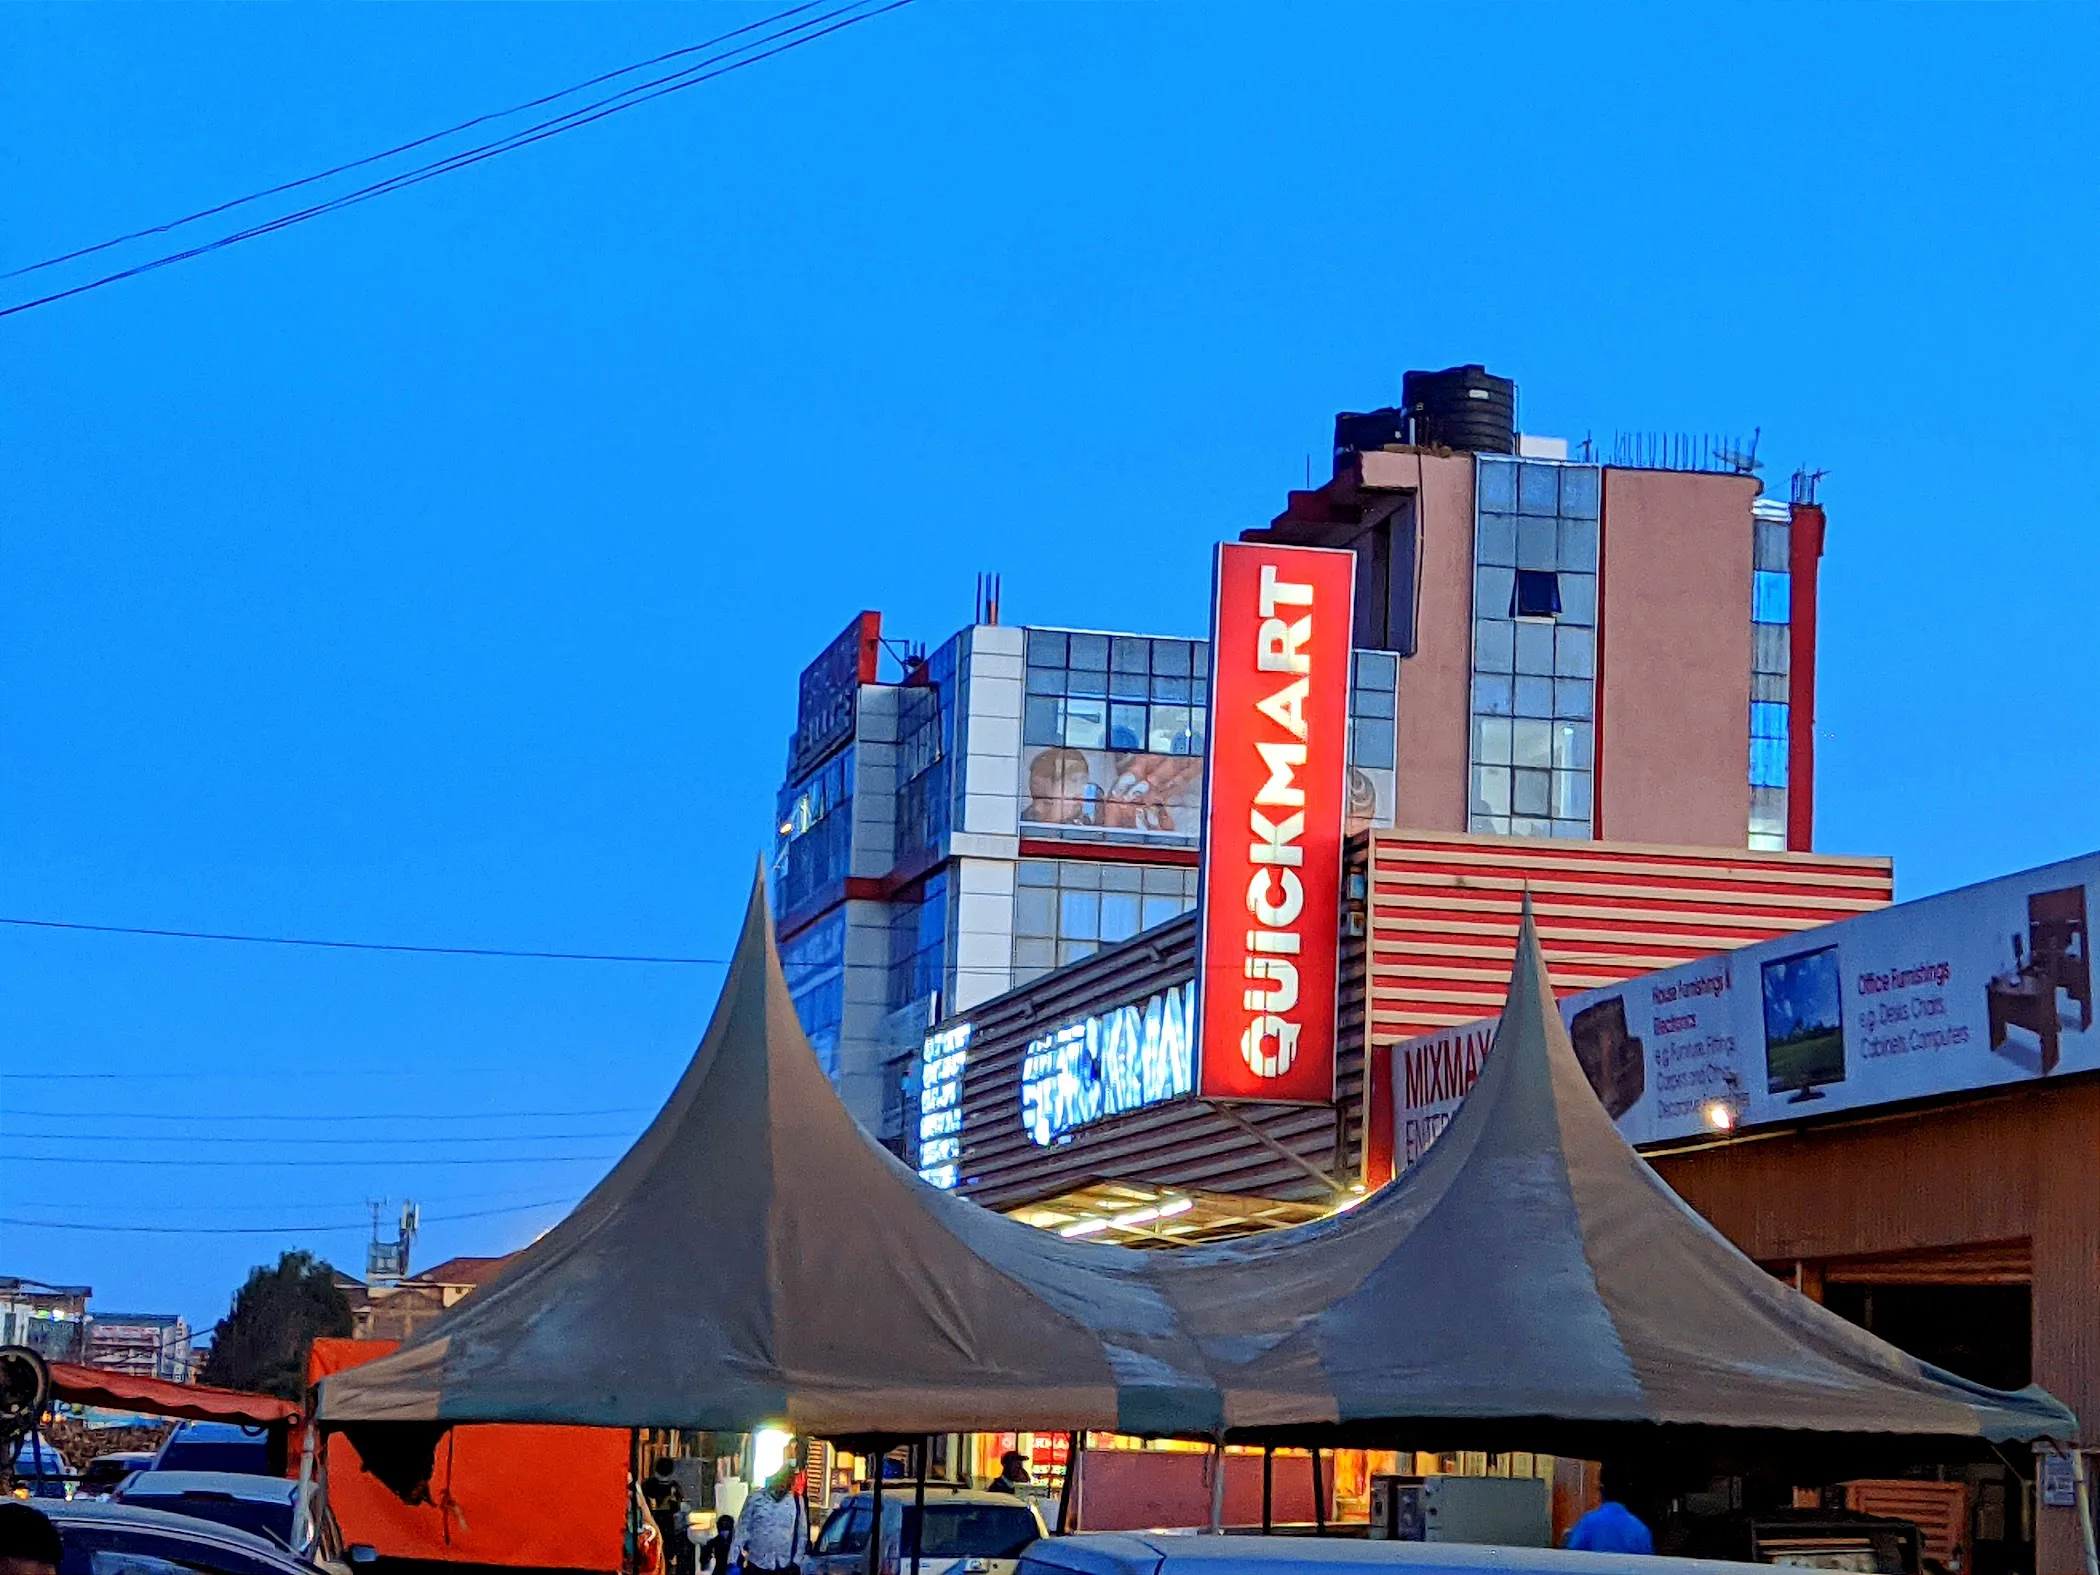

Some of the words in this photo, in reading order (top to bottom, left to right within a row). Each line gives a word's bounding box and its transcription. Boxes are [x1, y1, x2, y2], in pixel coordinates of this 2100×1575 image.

[1241, 564, 1314, 1078] QUICKMART
[1858, 972, 1889, 995] Office
[1891, 961, 1949, 988] Furnishings
